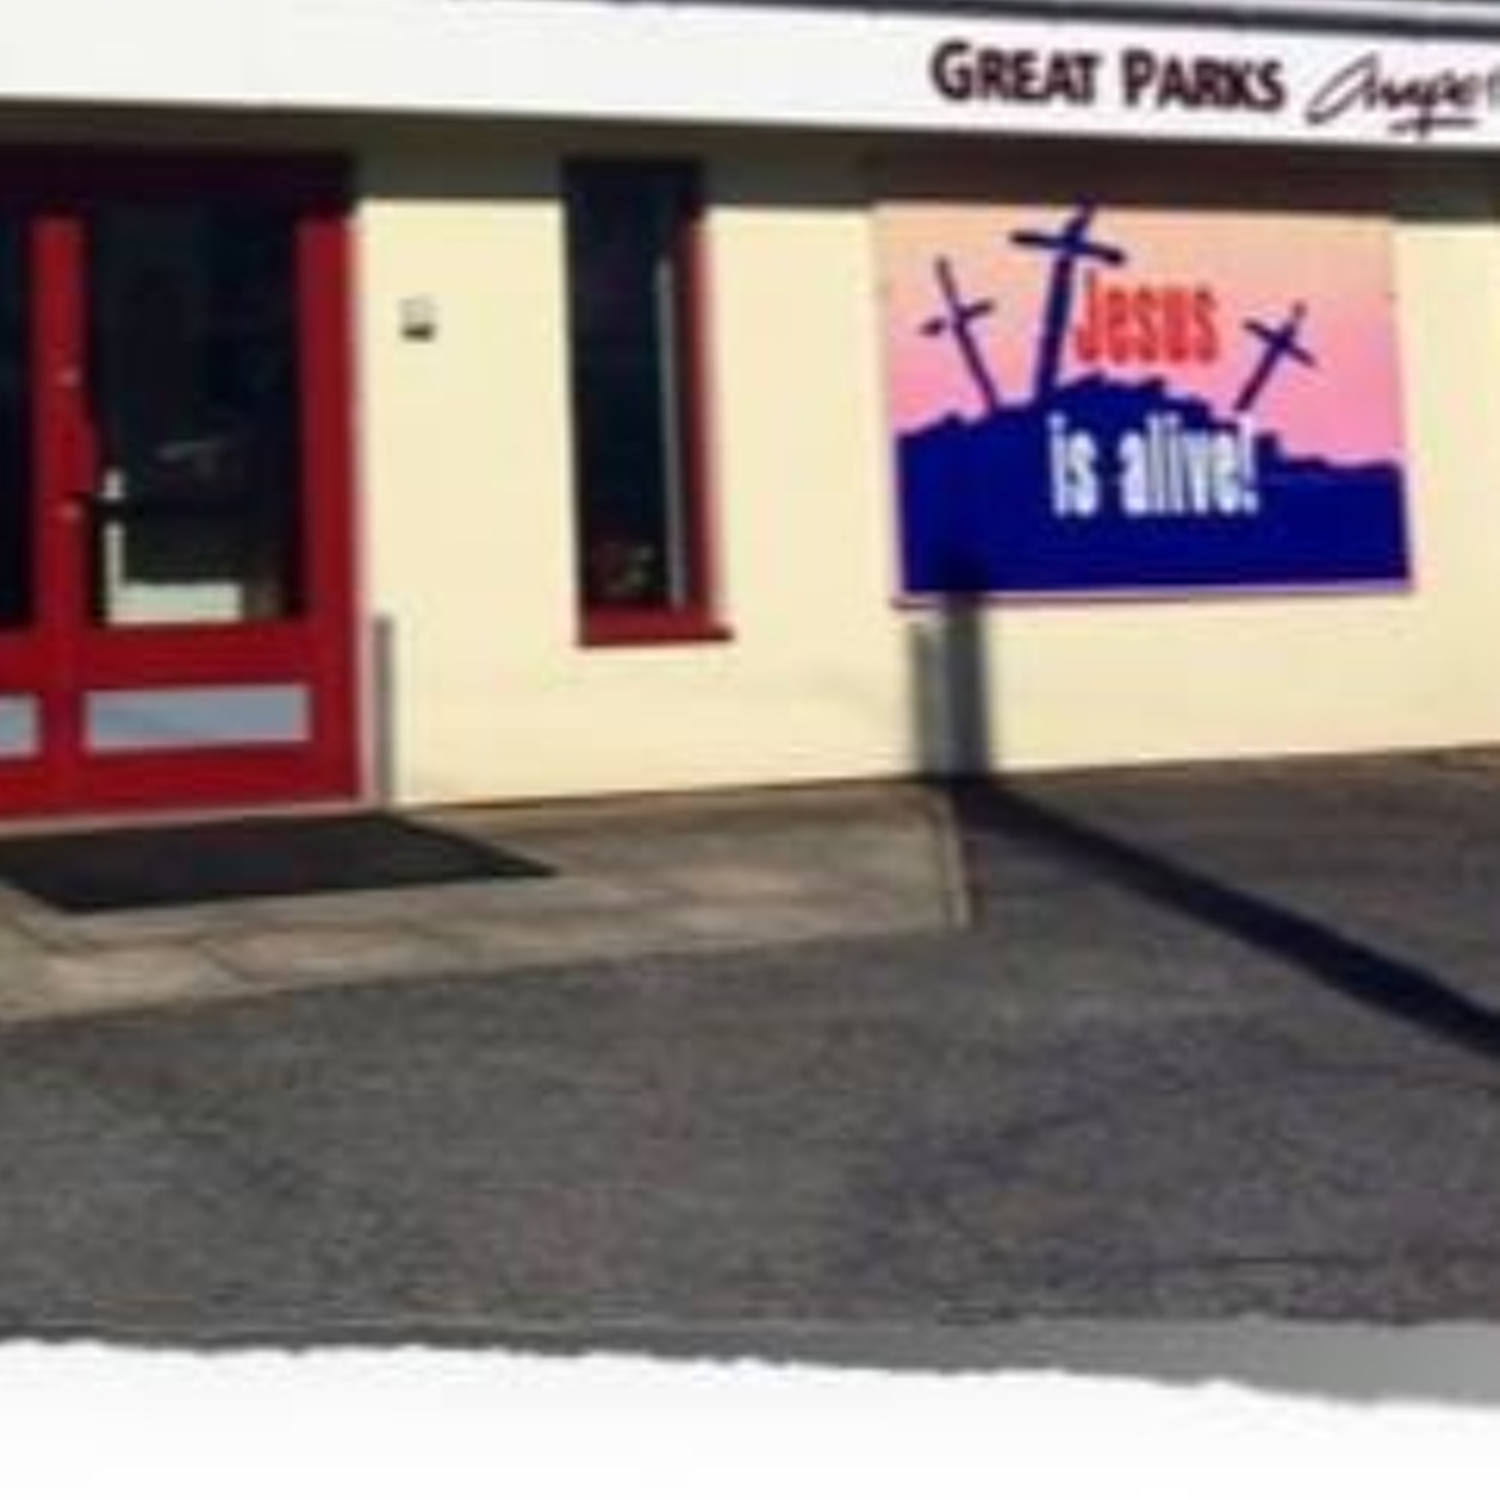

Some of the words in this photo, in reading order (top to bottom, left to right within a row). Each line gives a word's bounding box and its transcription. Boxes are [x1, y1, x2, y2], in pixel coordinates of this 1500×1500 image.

[930, 37, 1104, 102] GREAT
[1120, 47, 1288, 113] PARKS
[1074, 268, 1221, 364] Jesus
[1049, 411, 1099, 518] is
[1119, 411, 1260, 518] alive!
